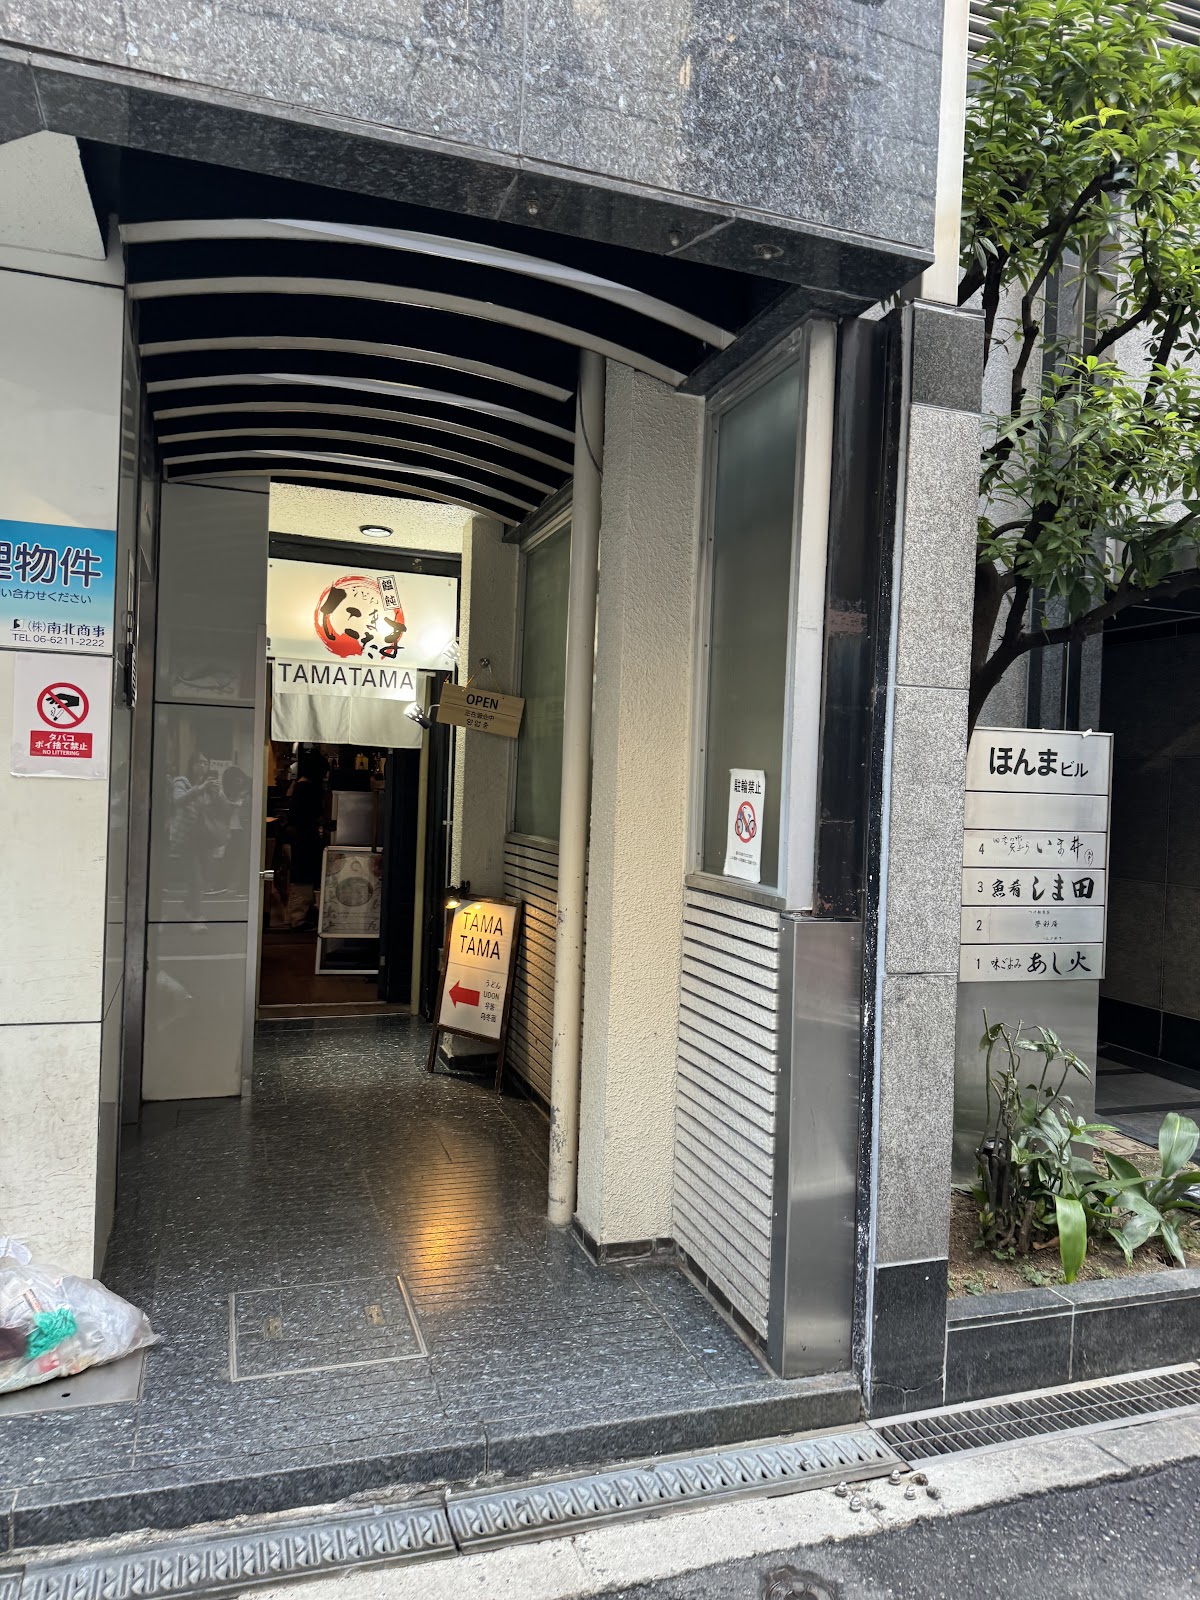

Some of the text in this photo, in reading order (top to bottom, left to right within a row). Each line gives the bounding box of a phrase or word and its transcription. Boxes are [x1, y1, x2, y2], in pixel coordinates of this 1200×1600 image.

[0, 541, 102, 588] 物件
[1, 588, 92, 604] い合わせください
[12, 633, 105, 647] TEL 06-6211-2222
[278, 663, 413, 690] TAMATAMA
[466, 693, 499, 710] OPEN
[49, 733, 75, 742] タバコ
[35, 740, 88, 751] ポイ捨て禁止
[734, 778, 761, 795] 駐輪禁止
[978, 843, 985, 855] 4
[977, 881, 984, 893] 3
[463, 911, 503, 936] TAMA
[976, 919, 983, 931] 2
[460, 935, 501, 960] TAMA
[976, 958, 981, 970] 1
[1027, 951, 1092, 975] あし火
[485, 979, 502, 990] うどん
[483, 990, 500, 1001] UDON
